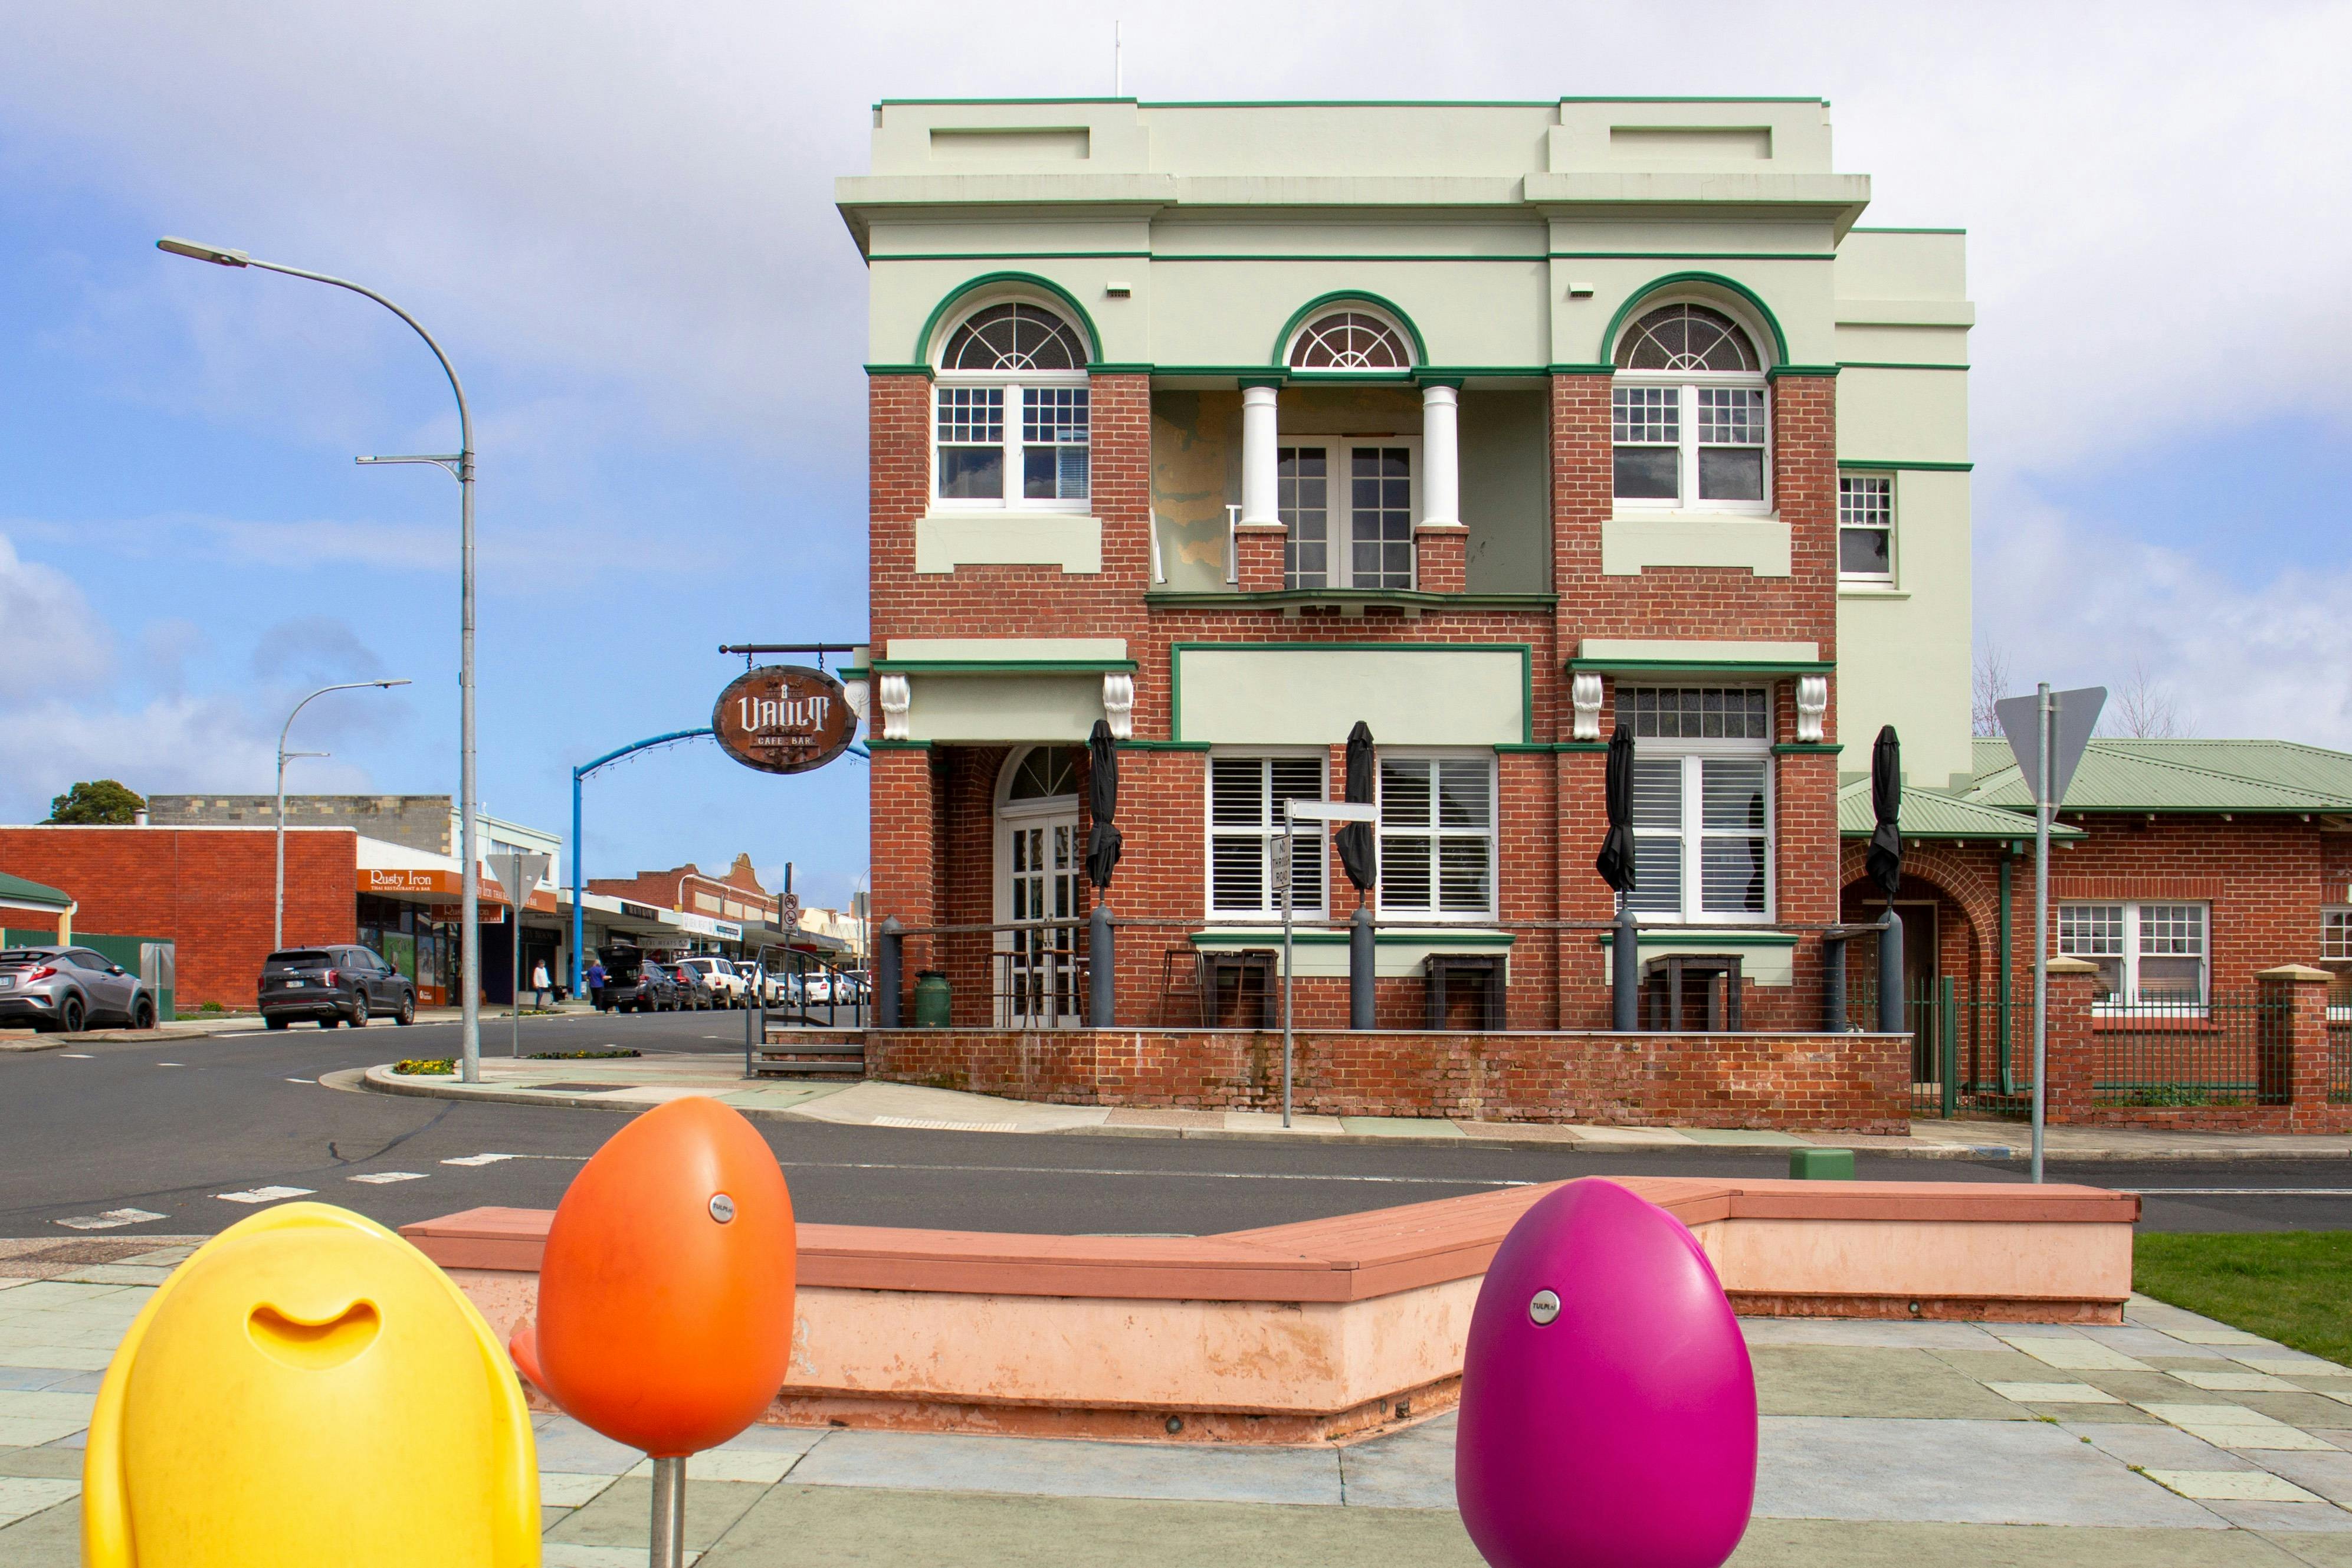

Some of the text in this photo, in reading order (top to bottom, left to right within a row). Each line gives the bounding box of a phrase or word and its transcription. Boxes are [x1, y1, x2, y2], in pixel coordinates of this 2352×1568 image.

[737, 696, 830, 732] VAULT
[1272, 856, 1290, 868] THROUGH
[370, 870, 432, 887] Rusty Iron
[1276, 870, 1287, 883] ROAD
[444, 905, 462, 916] Rus
